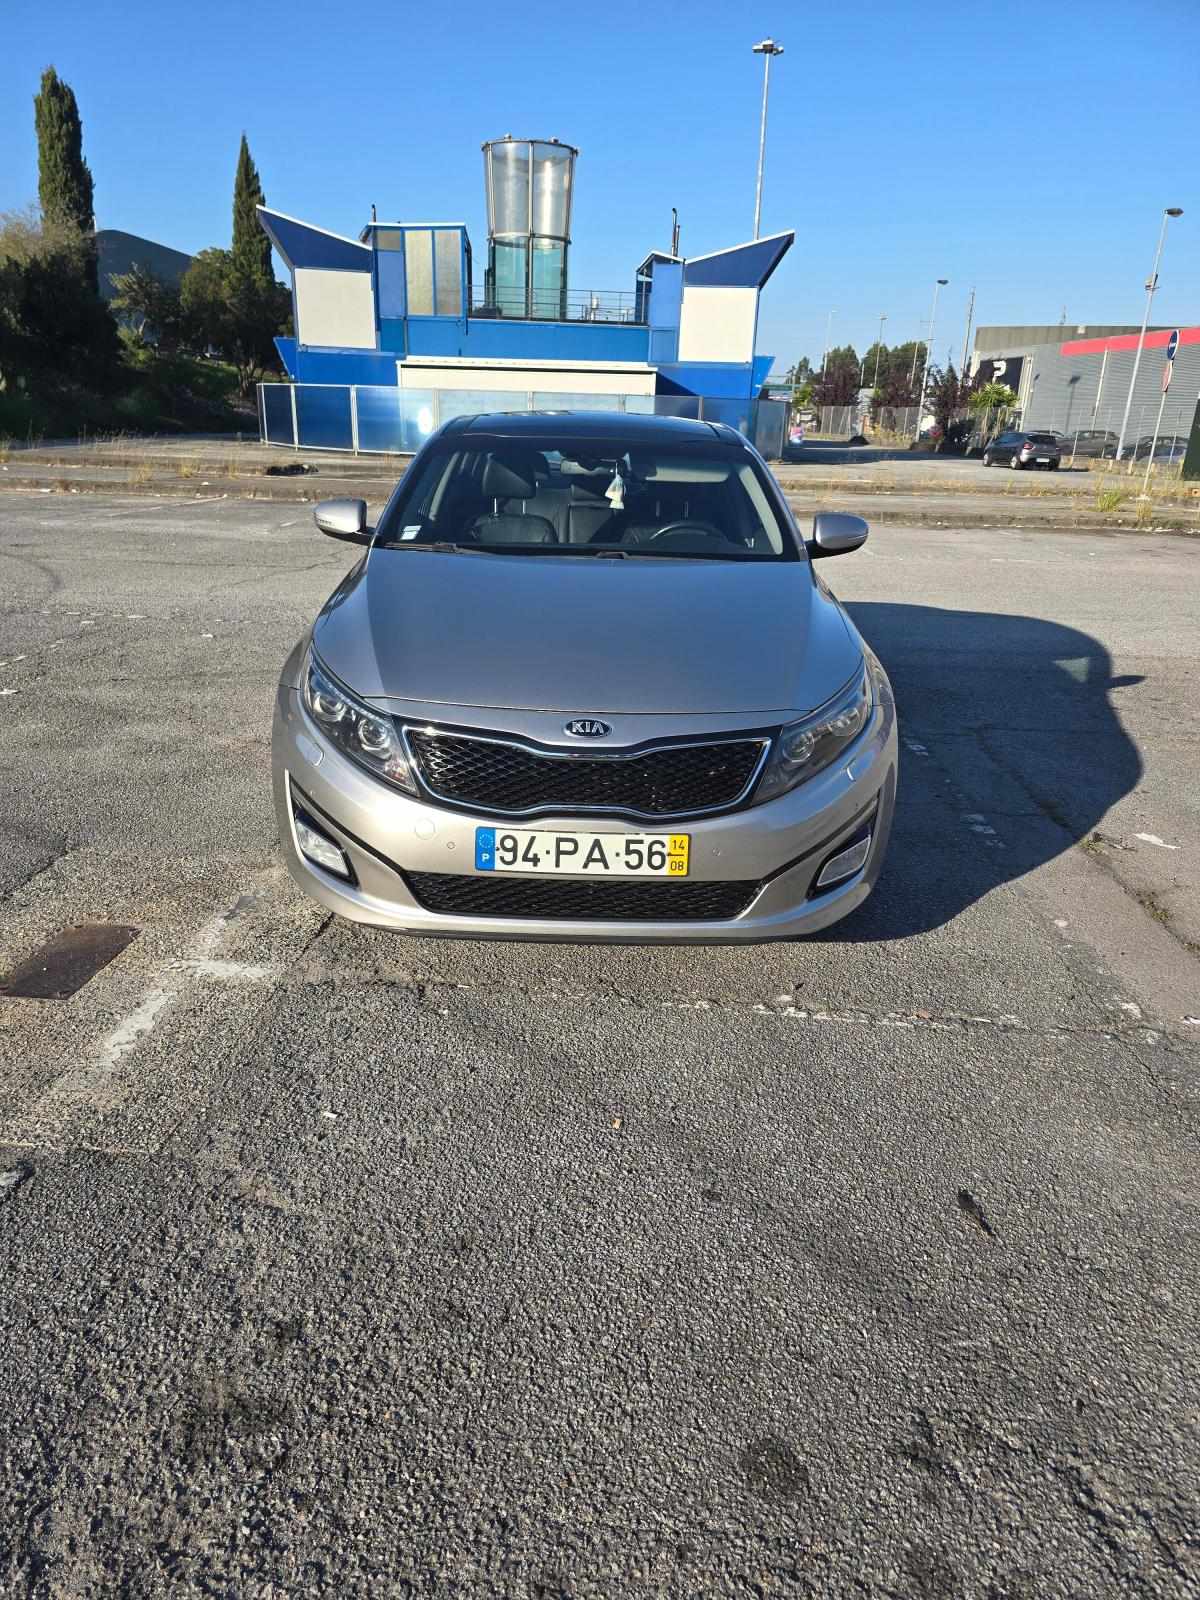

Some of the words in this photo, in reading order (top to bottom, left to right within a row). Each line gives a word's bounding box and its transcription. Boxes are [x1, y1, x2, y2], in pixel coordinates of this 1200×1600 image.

[572, 721, 604, 734] KIA
[672, 839, 685, 850] 14
[481, 853, 490, 862] P
[670, 860, 684, 871] 08
